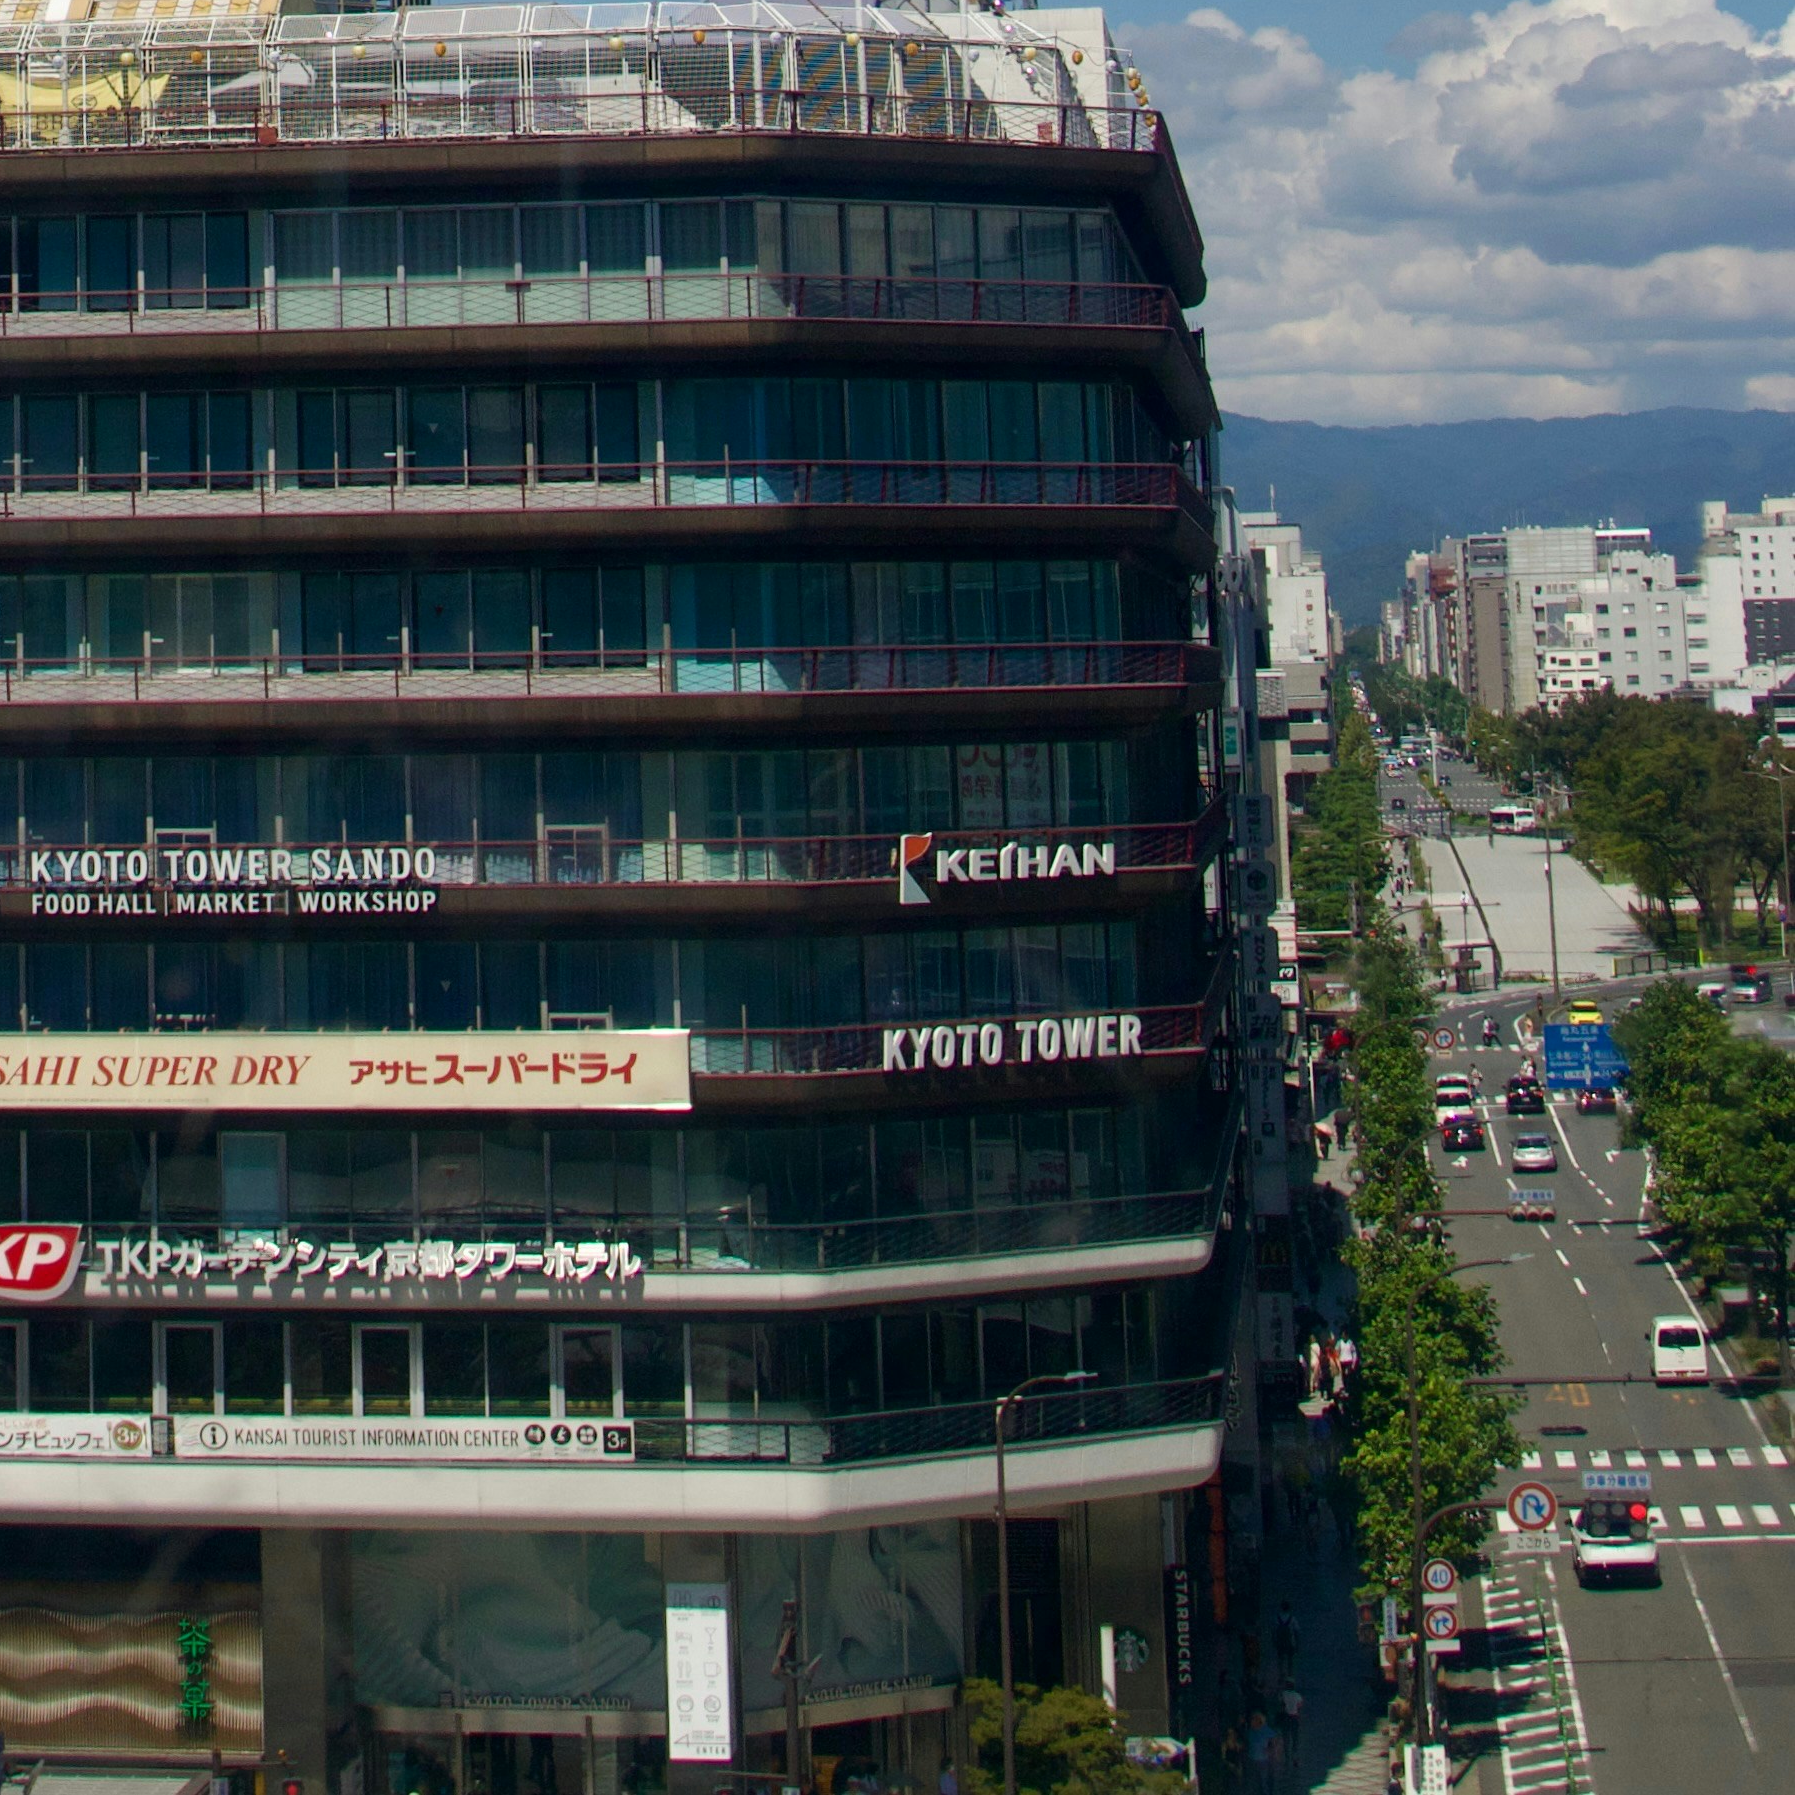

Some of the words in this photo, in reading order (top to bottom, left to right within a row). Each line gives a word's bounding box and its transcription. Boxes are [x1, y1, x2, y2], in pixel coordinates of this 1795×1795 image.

[31, 849, 150, 883] KYOTO
[163, 848, 294, 882] TOWER
[311, 847, 437, 881] SANDO
[936, 842, 1115, 883] KEIHAN
[31, 892, 91, 916] FOOD
[97, 892, 157, 915] HALL
[176, 891, 276, 914] MARKET
[298, 889, 437, 913] WORKSHOP
[883, 1023, 1004, 1072] KYOTO
[1015, 1015, 1143, 1063] TOWER
[92, 1055, 219, 1087] SUPER
[230, 1055, 312, 1086] DRY
[349, 1052, 638, 1086] アサヒスーパードライ
[95, 1238, 642, 1280] TKPガーデンシティ京都タワーホテル
[116, 1427, 140, 1444] 3F
[234, 1427, 288, 1446] KANSAI
[292, 1428, 357, 1446] TOURIST
[362, 1428, 459, 1447] INFORMATION
[464, 1429, 519, 1447] CENTER
[607, 1430, 628, 1449] 3F
[1430, 1569, 1448, 1584] 40
[1173, 1569, 1193, 1687] STARBUCKS
[176, 1618, 214, 1721] 茶の菓
[847, 1680, 889, 1699] TOWER
[892, 1673, 934, 1692] SANDO
[520, 1694, 574, 1709] TOWER
[578, 1694, 632, 1710] SANDO
[695, 1745, 727, 1756] ENTER
